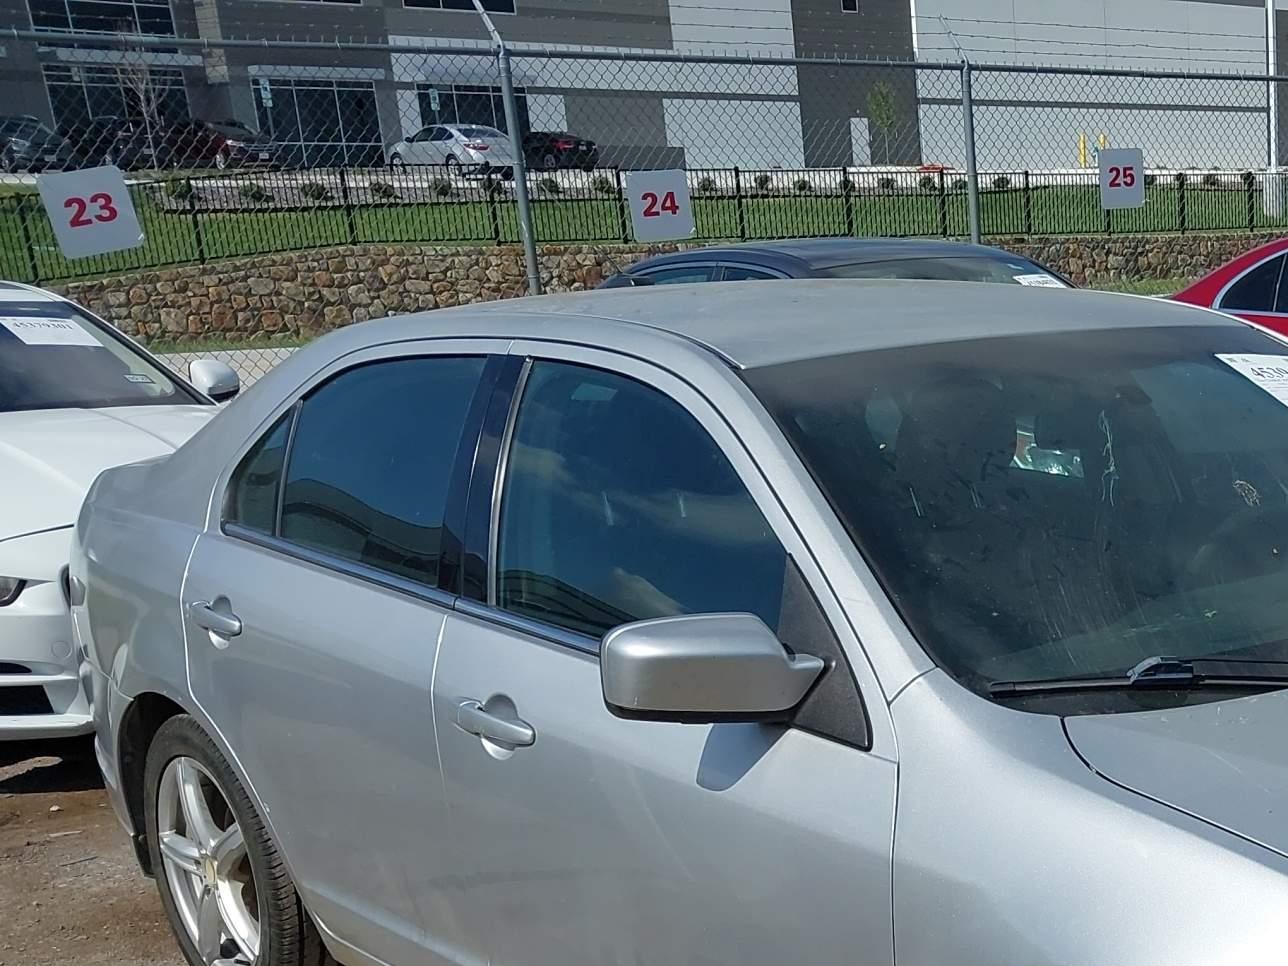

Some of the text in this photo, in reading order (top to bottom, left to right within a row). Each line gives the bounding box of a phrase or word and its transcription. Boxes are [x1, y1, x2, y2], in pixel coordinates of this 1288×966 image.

[1108, 166, 1135, 188] 25
[63, 192, 118, 228] 23
[641, 191, 680, 217] 24
